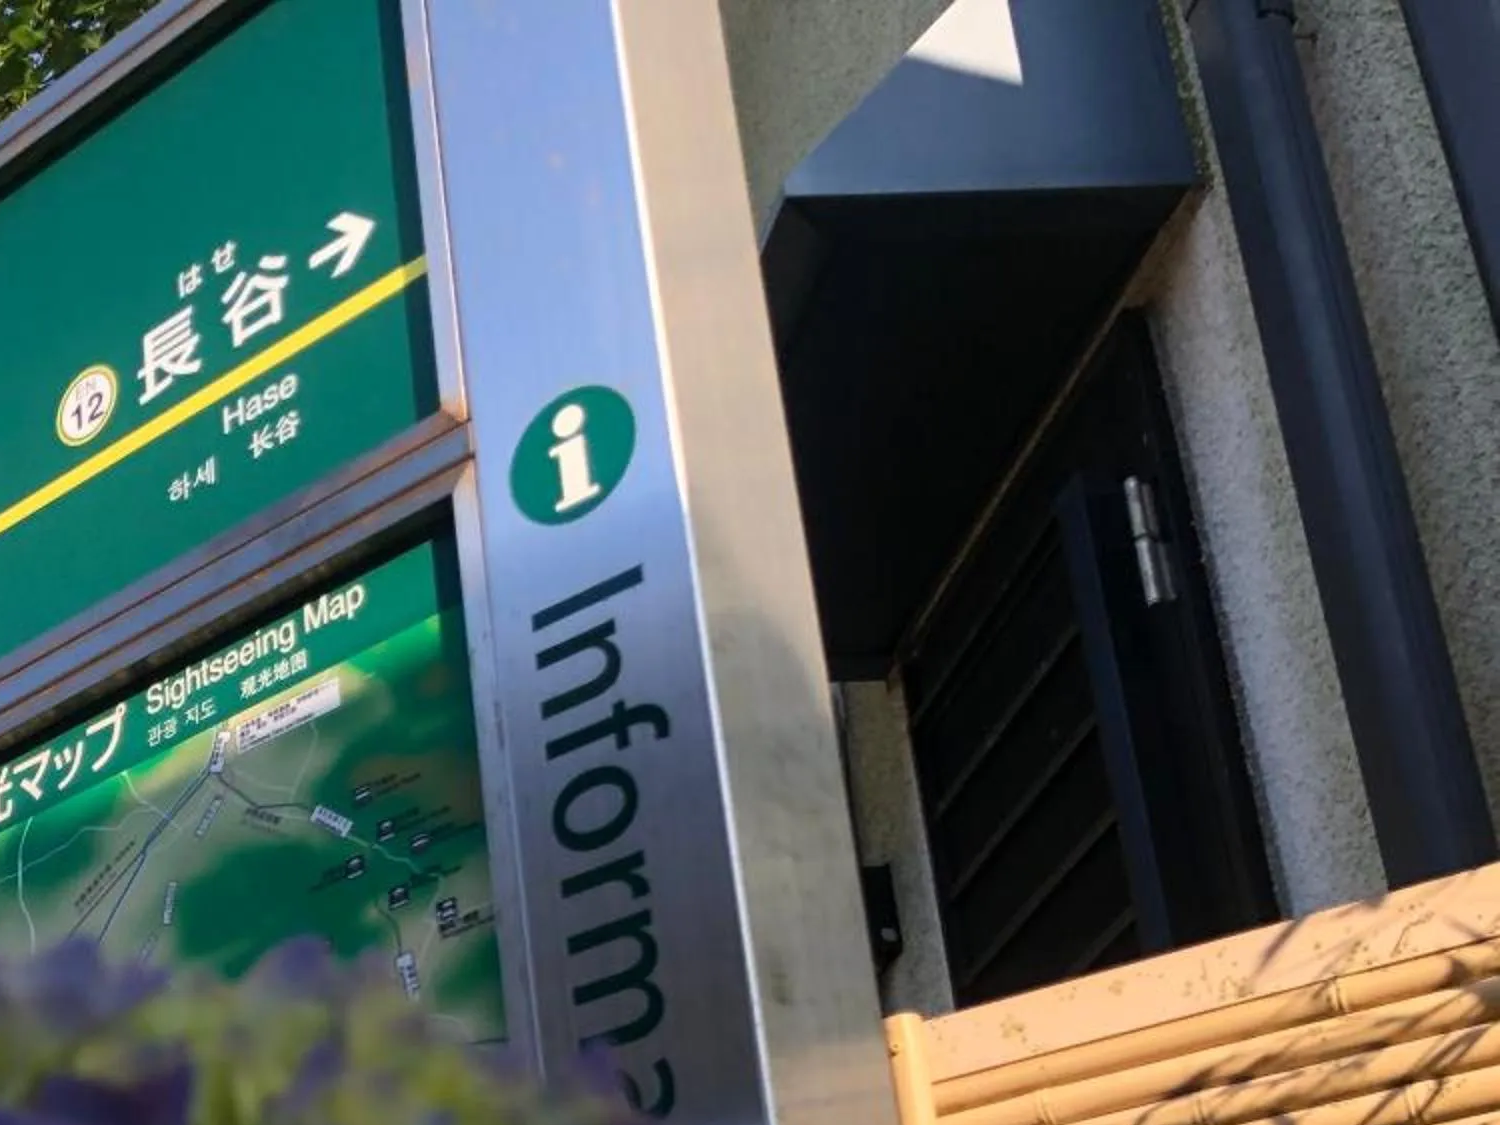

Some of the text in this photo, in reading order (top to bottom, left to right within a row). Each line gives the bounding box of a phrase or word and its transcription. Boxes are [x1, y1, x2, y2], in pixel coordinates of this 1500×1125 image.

[177, 240, 237, 299] はせ
[136, 255, 290, 405] 長谷
[70, 391, 104, 431] 12
[222, 373, 299, 434] Hase
[248, 411, 301, 459] 长谷
[168, 457, 217, 501] 하세
[146, 582, 367, 716] Sightseeing Map
